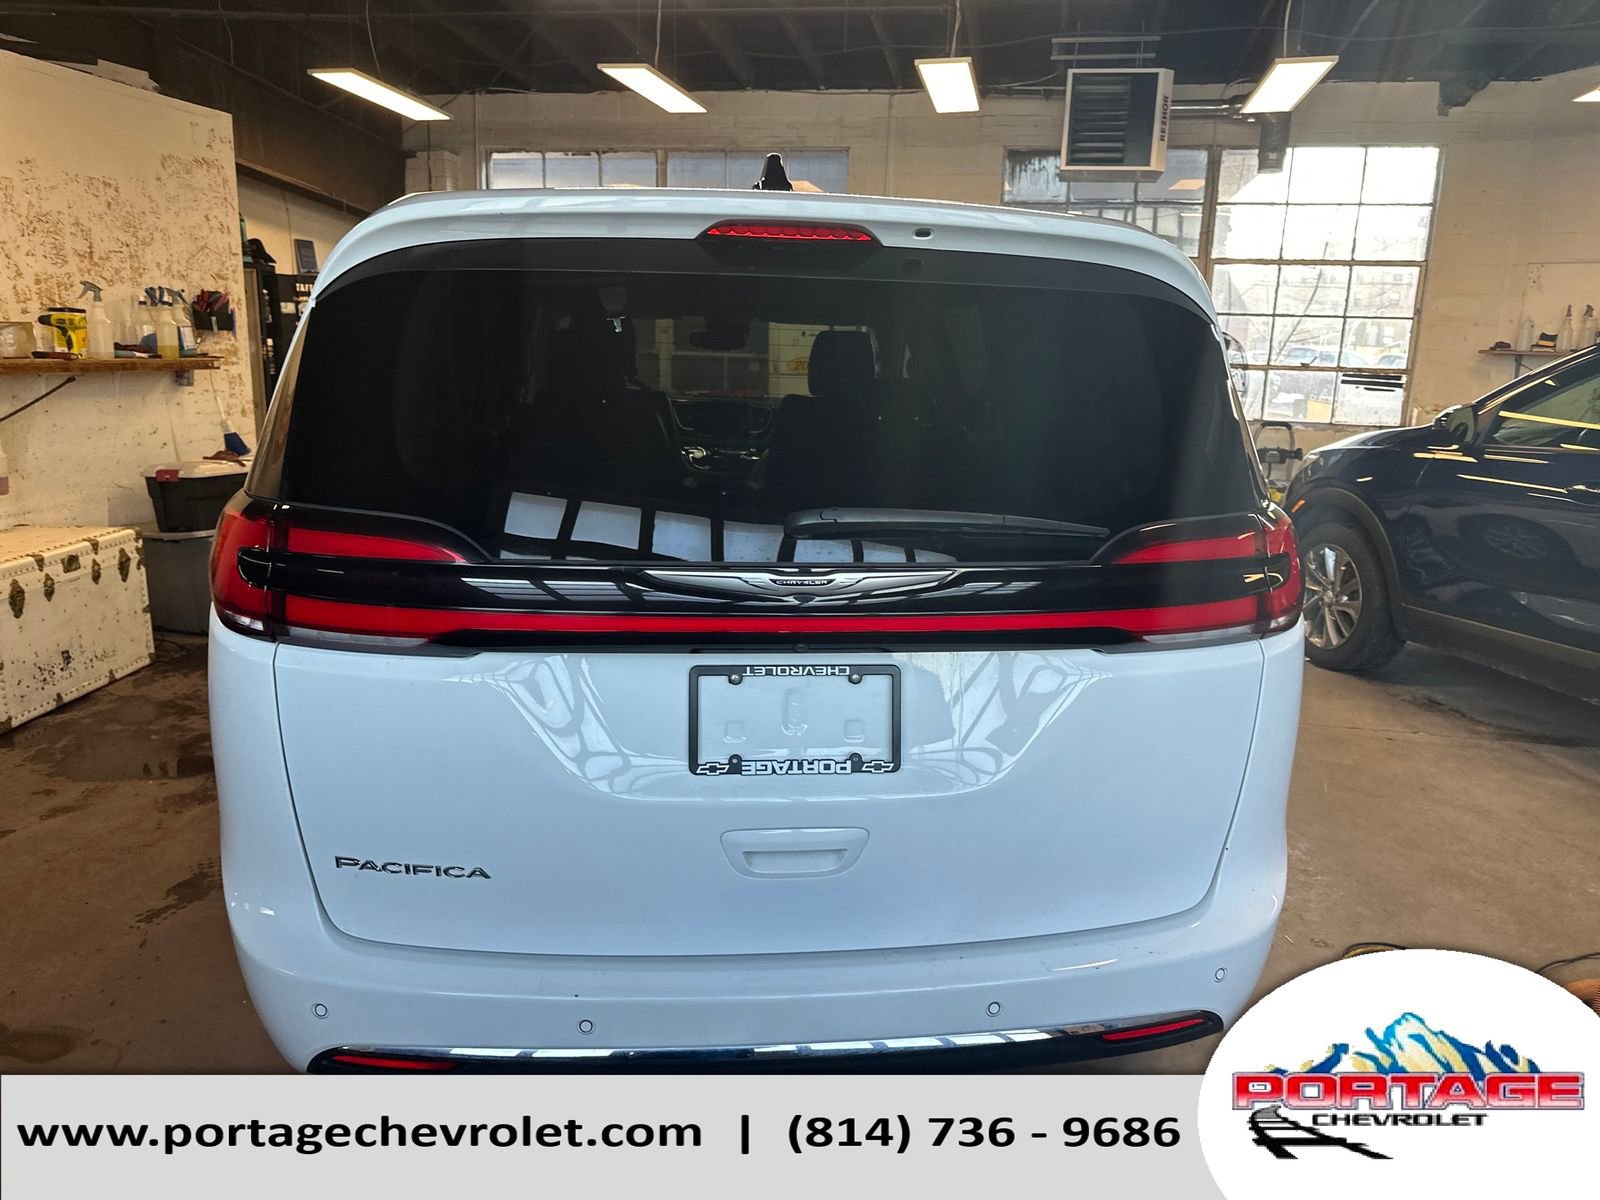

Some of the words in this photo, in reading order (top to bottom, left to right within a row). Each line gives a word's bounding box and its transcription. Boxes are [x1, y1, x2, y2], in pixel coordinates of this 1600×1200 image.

[742, 666, 850, 676] CHEVROLET
[741, 759, 852, 775] PORTAGE
[335, 856, 491, 879] PACIFICA
